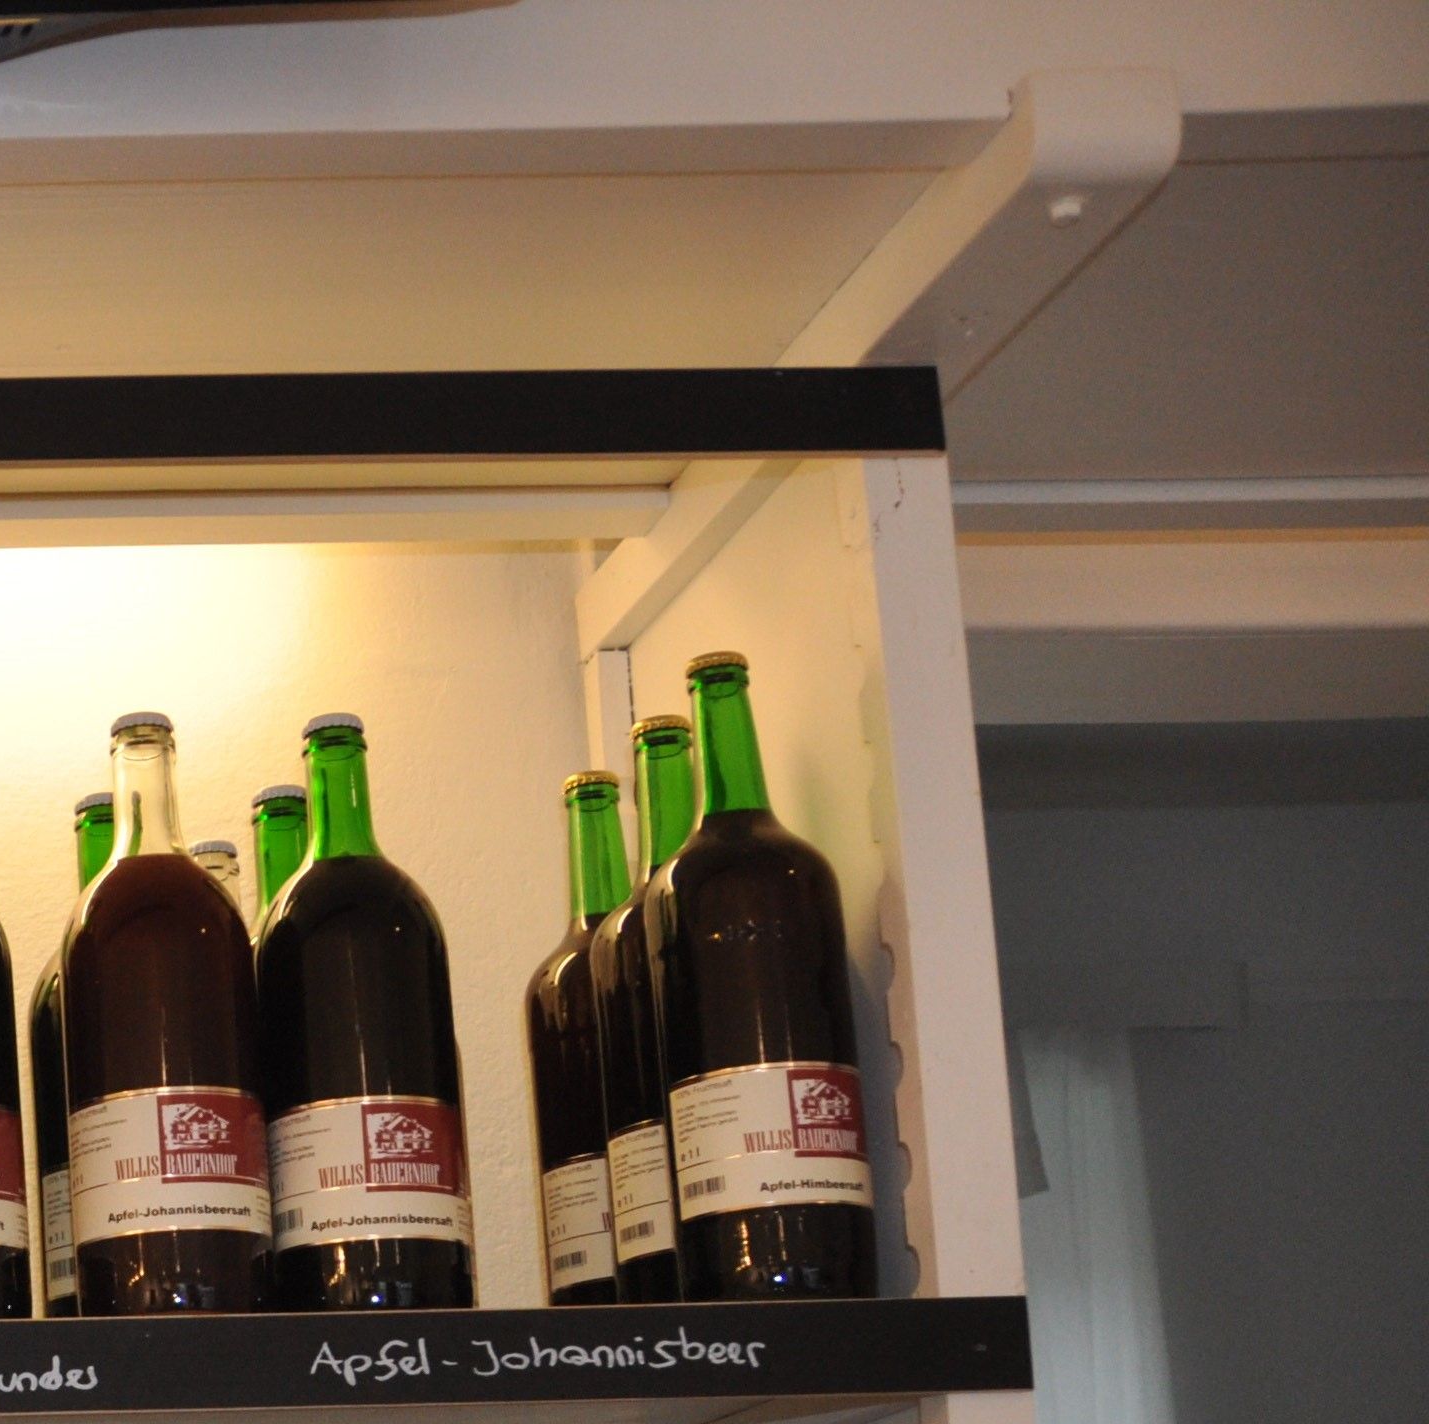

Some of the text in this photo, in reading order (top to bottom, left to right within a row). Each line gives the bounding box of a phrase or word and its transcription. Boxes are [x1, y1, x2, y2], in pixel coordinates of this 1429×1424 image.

[744, 1129, 791, 1153] WILLIS
[115, 1153, 238, 1180] WILLIS BAUERNHOF
[318, 1162, 440, 1189] WILLIS BAUERNHOF
[108, 1206, 251, 1223] Apfel-Johannisbeersaft
[310, 1214, 453, 1232] Apfel-Johannisbeersaft
